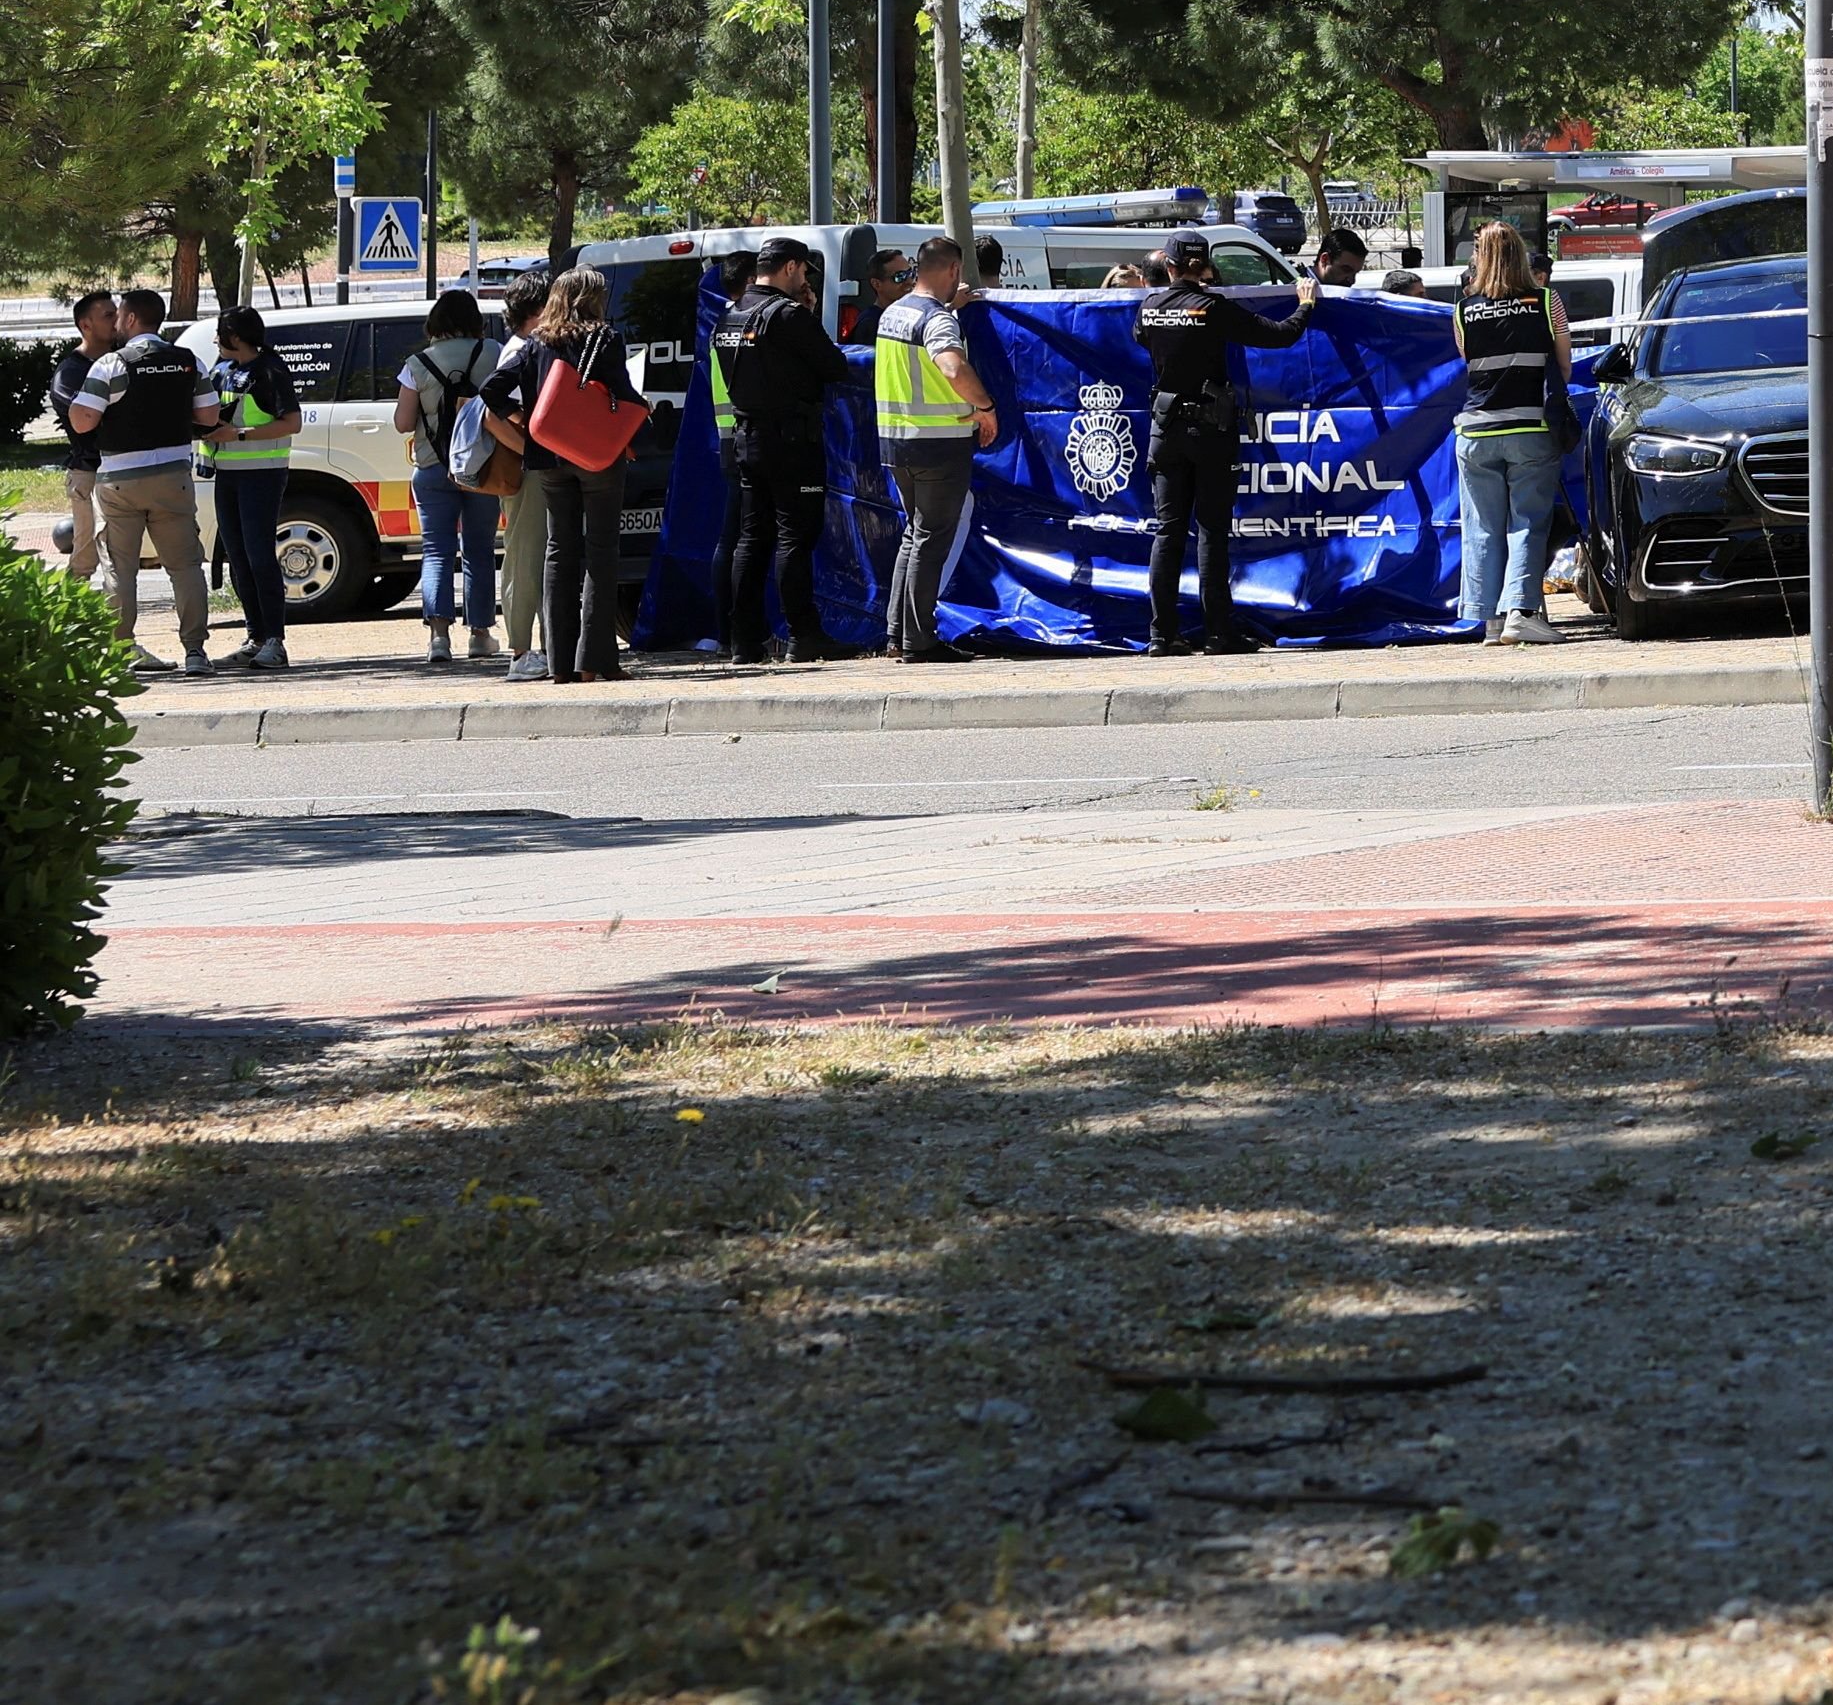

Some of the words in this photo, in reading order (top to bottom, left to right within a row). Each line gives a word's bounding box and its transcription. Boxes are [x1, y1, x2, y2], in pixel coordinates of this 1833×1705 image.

[1609, 167, 1635, 175] América
[1642, 166, 1664, 176] Colegio
[1464, 298, 1521, 315] POLICIA
[1142, 309, 1189, 318] POLICIA
[1465, 305, 1539, 324] NACIONAL
[1142, 318, 1206, 327] NACIONAL
[273, 343, 321, 352] Ayuntamiento
[136, 365, 184, 375] POLICIA
[1228, 510, 1397, 537] IENTÍFICA
